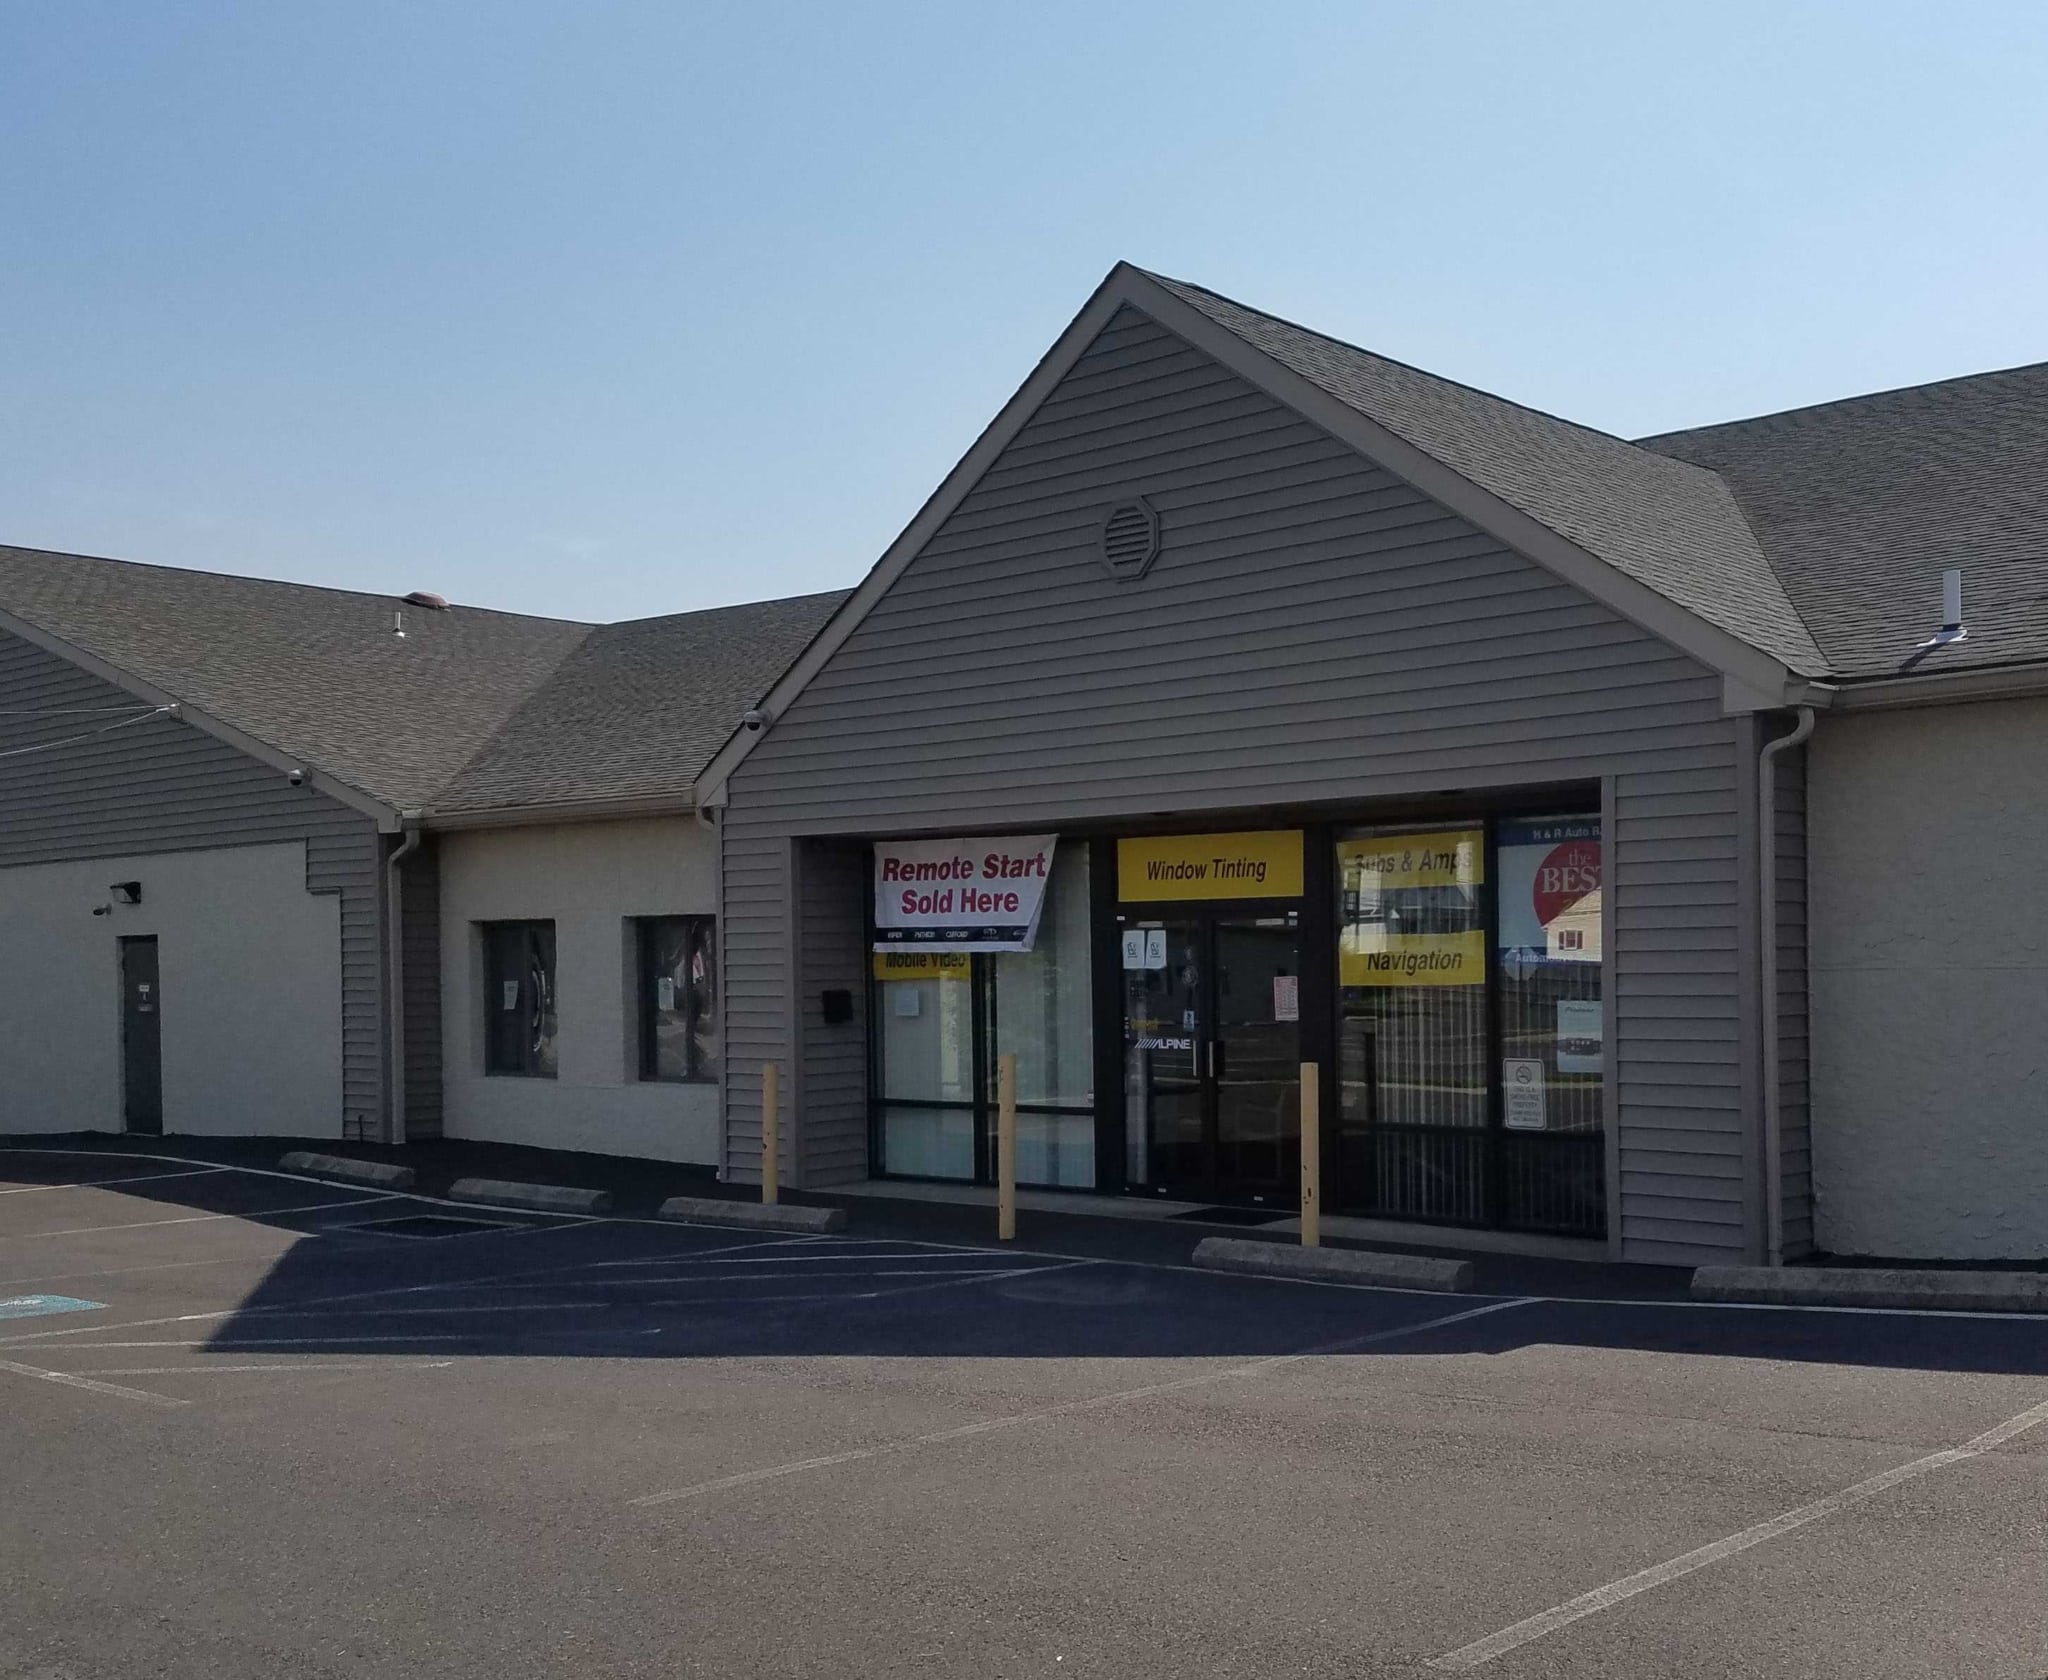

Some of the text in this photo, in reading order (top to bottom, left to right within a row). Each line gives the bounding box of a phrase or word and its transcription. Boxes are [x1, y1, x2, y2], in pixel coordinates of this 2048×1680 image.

[1554, 828, 1562, 838] R
[1565, 827, 1589, 838] Auto
[882, 852, 1046, 882] Remote Start
[1401, 849, 1413, 873] &
[1568, 849, 1592, 866] the
[1147, 857, 1267, 883] Window Tinting
[901, 888, 1019, 914] Sold Here
[886, 952, 966, 969] Mobile Video
[1367, 949, 1463, 976] Navigation
[1152, 1038, 1192, 1050] ALPINE
